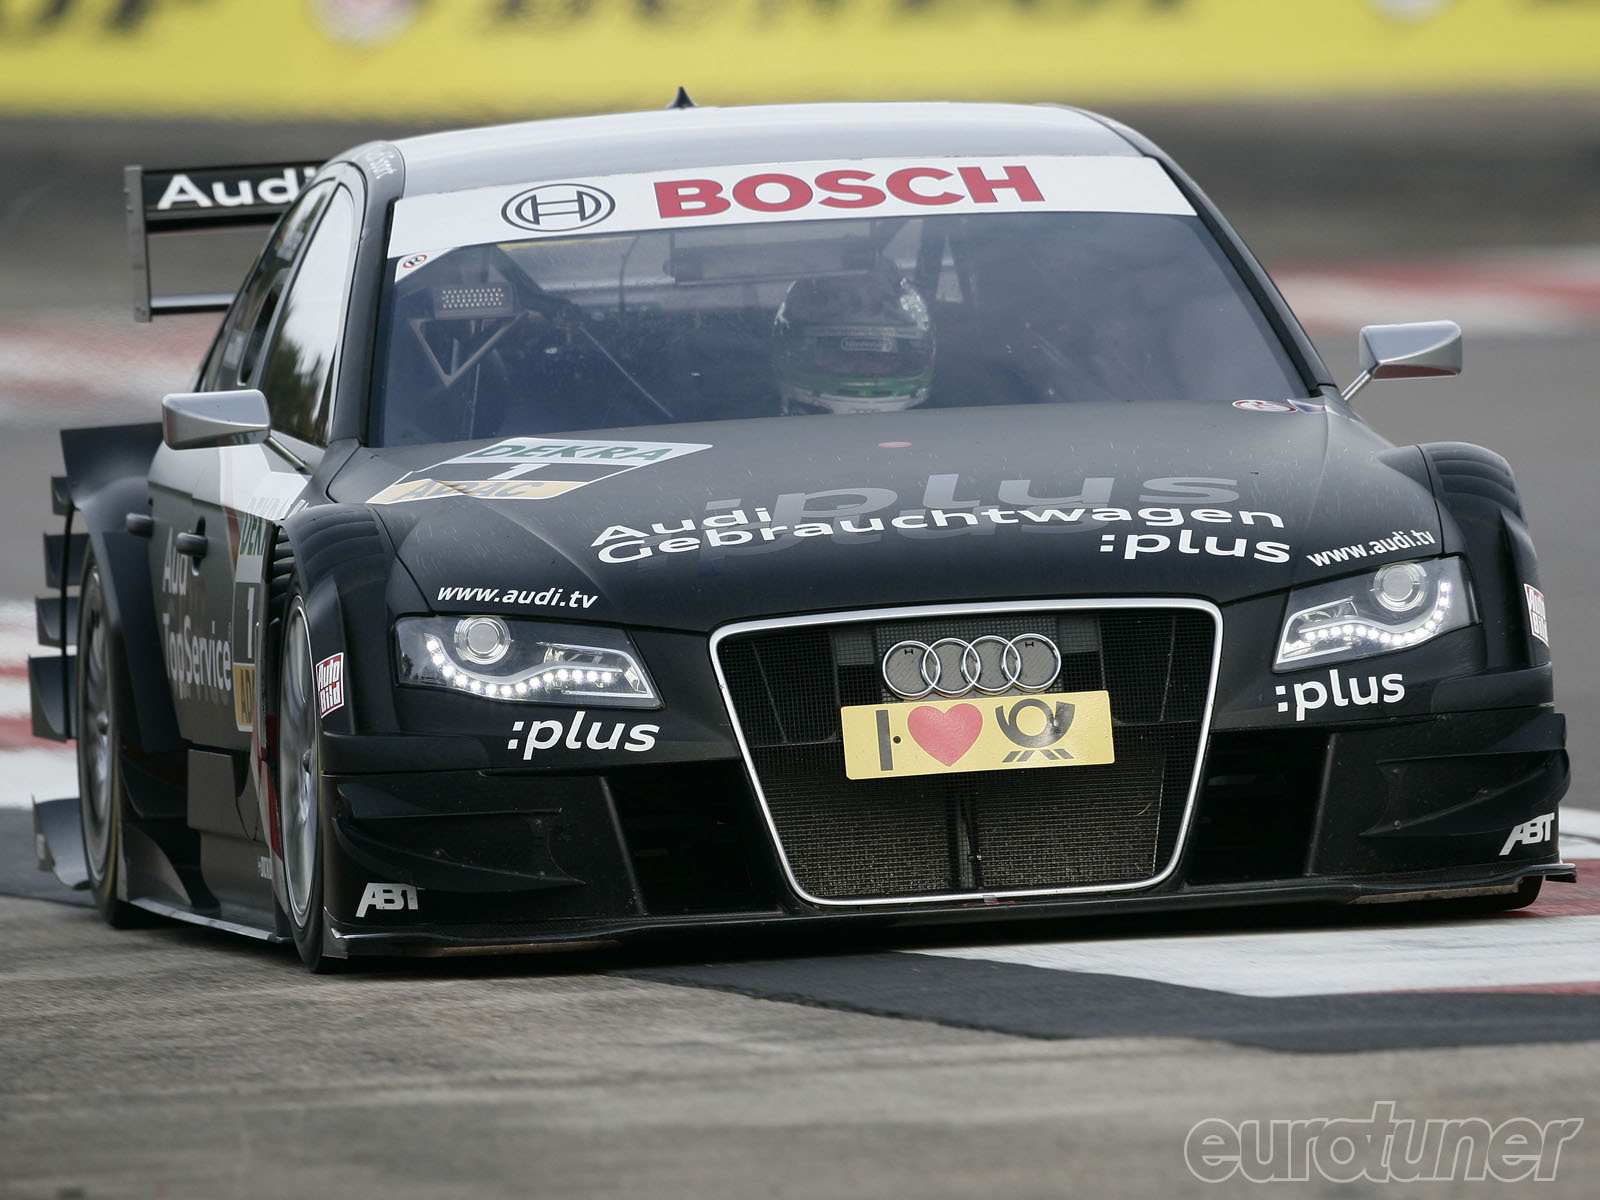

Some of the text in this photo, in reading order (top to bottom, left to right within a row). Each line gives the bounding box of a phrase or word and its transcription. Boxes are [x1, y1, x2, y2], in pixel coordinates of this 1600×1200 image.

[653, 165, 1046, 219] BOSCH
[463, 444, 673, 462] DEKRA
[487, 463, 551, 481] 1
[591, 507, 772, 547] Audi
[597, 507, 1285, 564] Gebrauchtwagen
[1099, 529, 1291, 563] :plus
[1305, 528, 1436, 568] www.audi.tv
[437, 586, 598, 609] www.audi.tv
[162, 612, 232, 698] TopService
[318, 659, 341, 691] Auto
[320, 681, 342, 713] Bild
[1274, 669, 1406, 722] :plus
[507, 711, 660, 760] :plus
[1499, 812, 1555, 856] ABT
[355, 882, 419, 918] ABT
